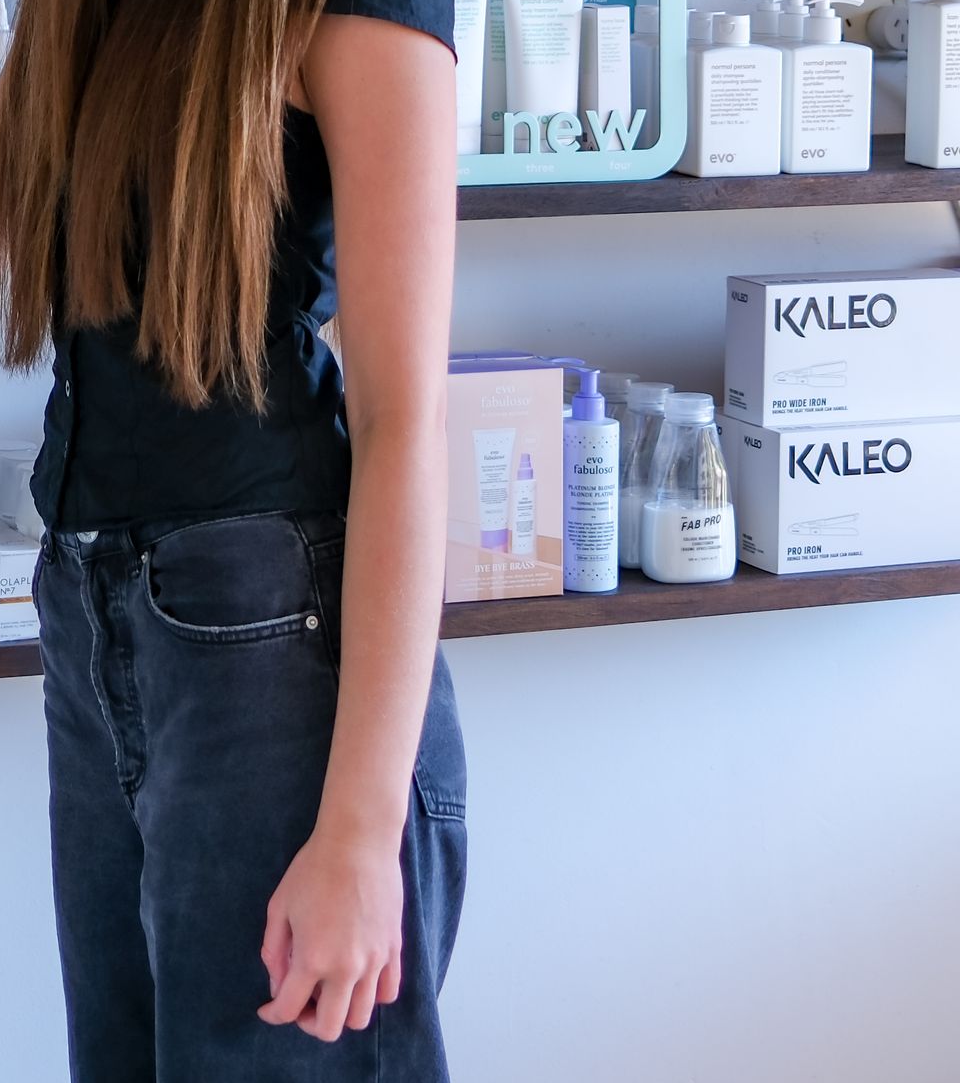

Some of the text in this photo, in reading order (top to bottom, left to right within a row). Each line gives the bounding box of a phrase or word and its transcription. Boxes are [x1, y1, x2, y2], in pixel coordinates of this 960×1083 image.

[503, 108, 646, 154] new
[732, 292, 748, 302] KALEO
[774, 293, 897, 338] KALEO
[772, 398, 826, 408] PRO WIDE IRON
[744, 436, 762, 449] KALEO
[789, 438, 912, 484] KALEO
[574, 464, 614, 474] fabuloso
[681, 515, 721, 531] FAB PRO
[804, 545, 822, 554] IRON
[475, 562, 535, 572] BYE BYE BRASS
